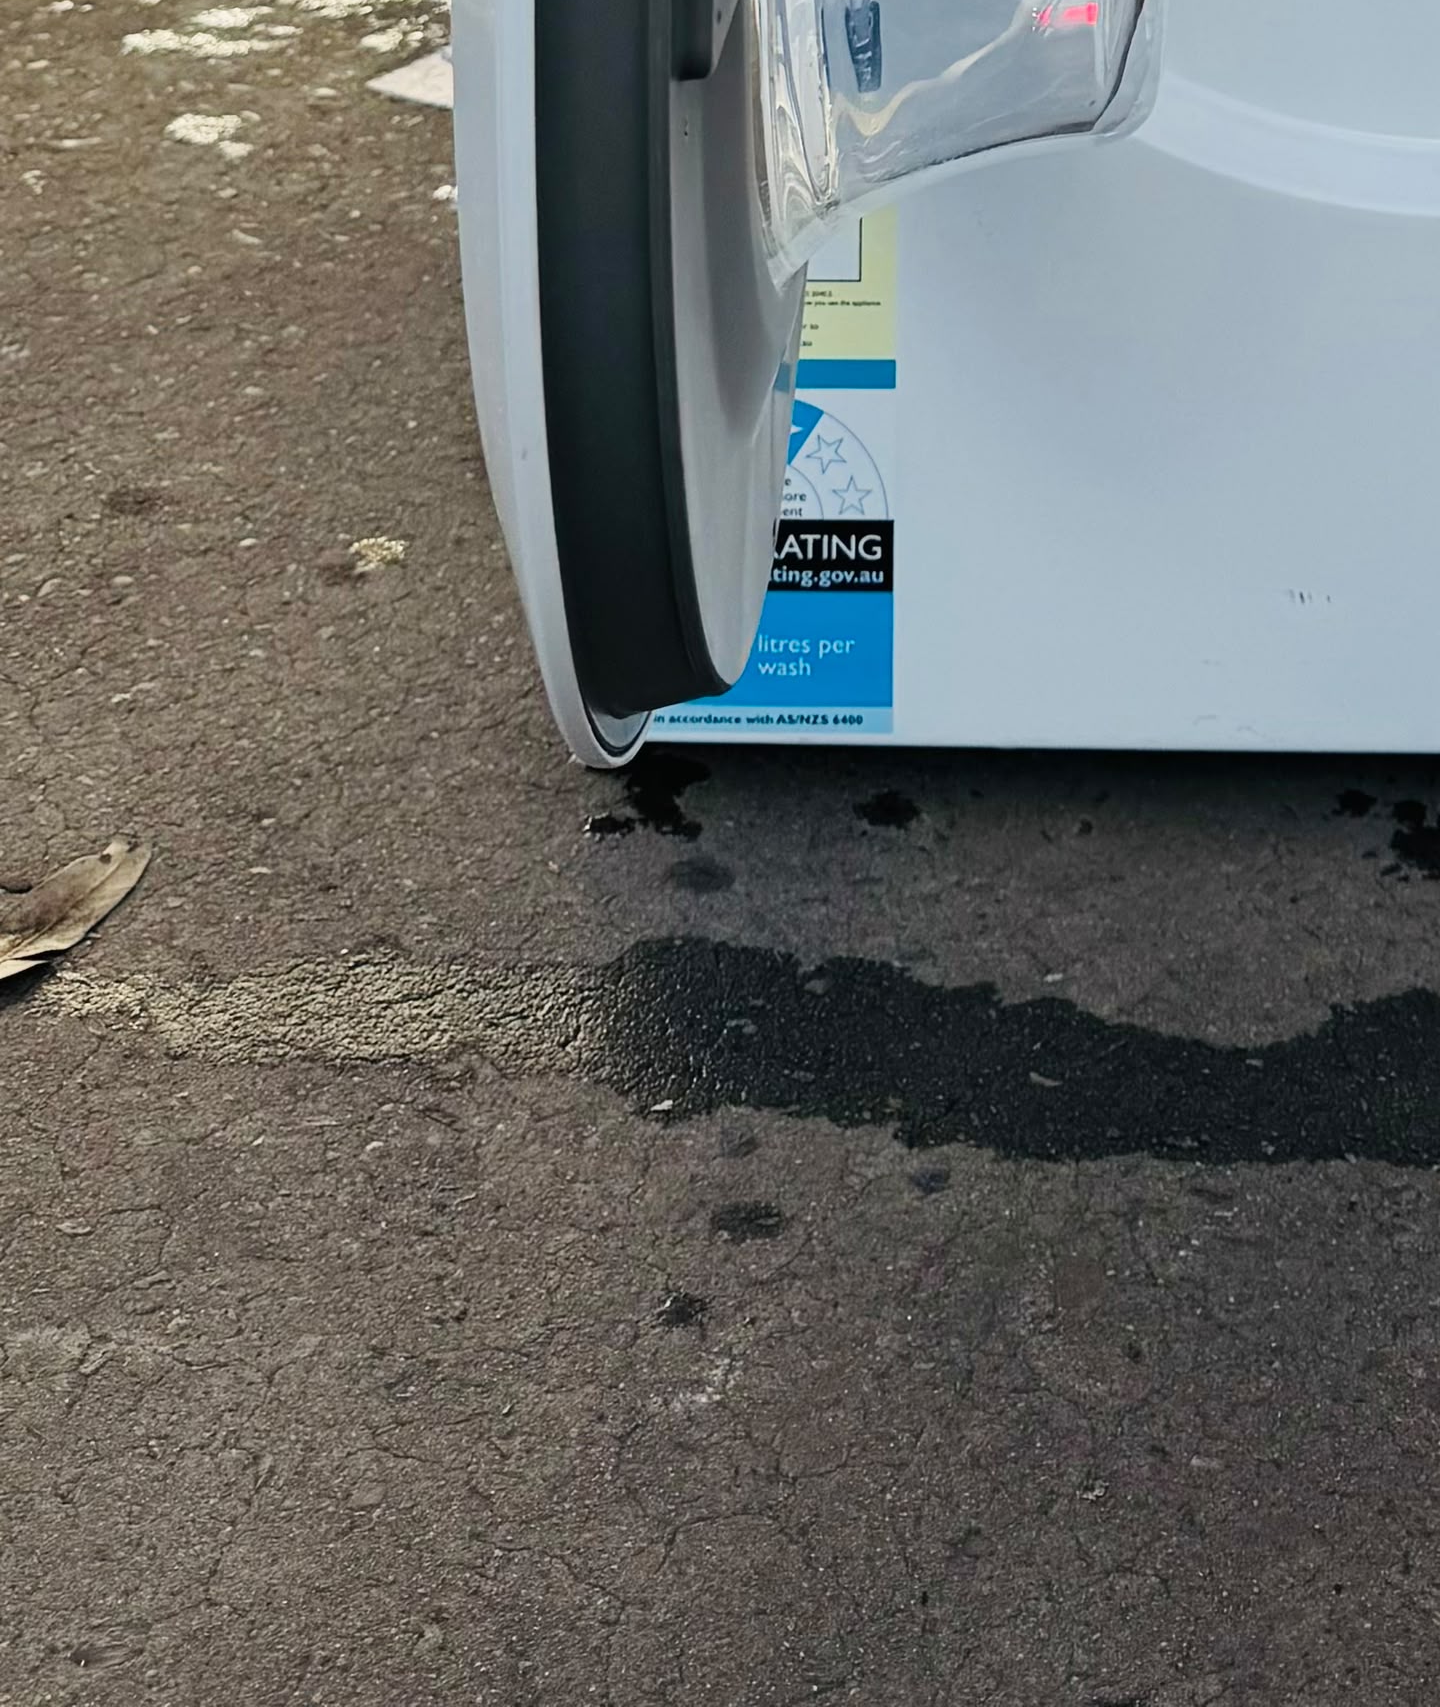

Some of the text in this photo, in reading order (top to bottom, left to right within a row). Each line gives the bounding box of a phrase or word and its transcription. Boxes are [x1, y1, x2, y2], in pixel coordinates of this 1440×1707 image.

[784, 493, 806, 501] ore
[774, 534, 882, 560] ATING
[773, 565, 884, 587] ting.gov.au
[759, 634, 855, 659] litres per
[758, 657, 810, 676] wash
[669, 714, 741, 724] accordance
[746, 714, 774, 724] with
[776, 714, 828, 725] AS/NZS
